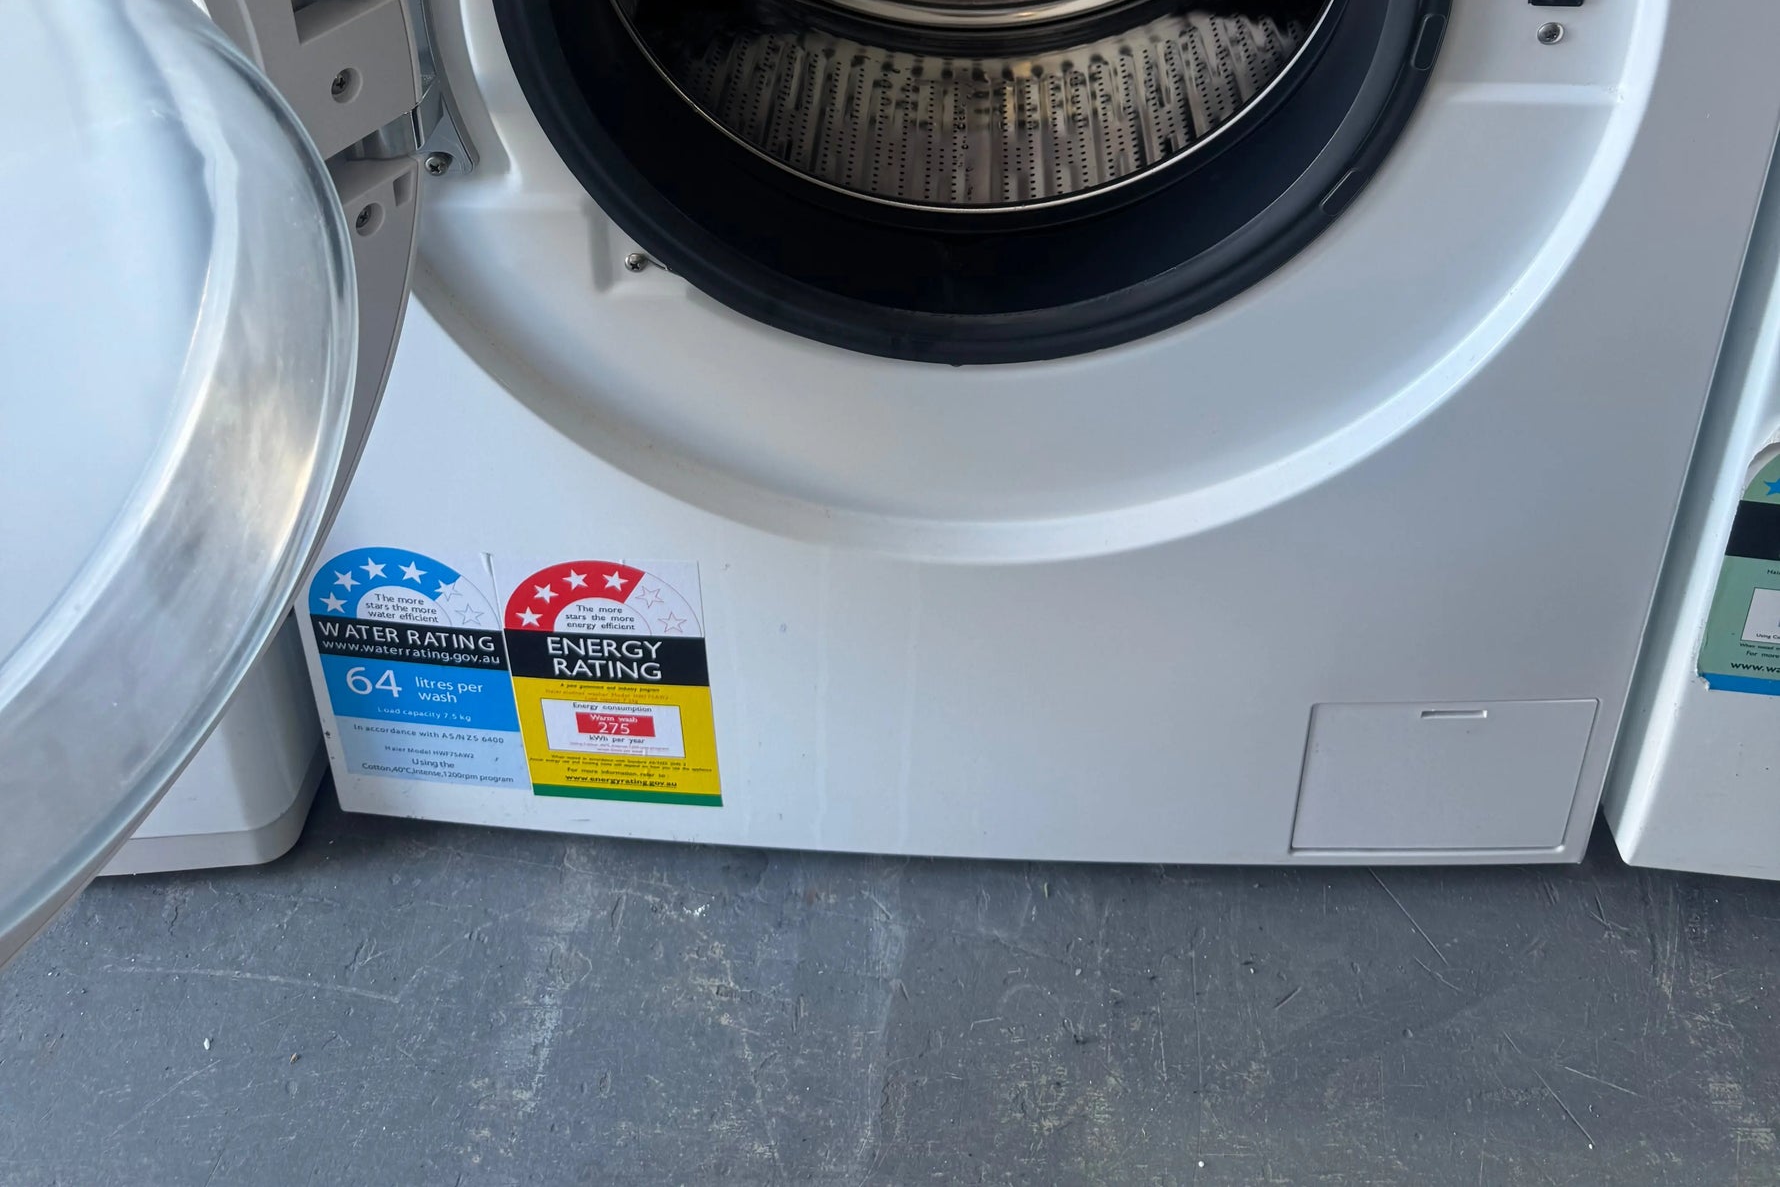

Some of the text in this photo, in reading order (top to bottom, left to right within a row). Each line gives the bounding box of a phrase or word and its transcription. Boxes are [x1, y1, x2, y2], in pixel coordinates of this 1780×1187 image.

[375, 593, 424, 605] The more
[366, 602, 437, 615] stars the more
[576, 604, 593, 613] The
[368, 610, 439, 623] water efficient
[592, 613, 606, 621] the
[567, 622, 635, 630] energy efficient
[318, 621, 495, 652] WATER RATING
[322, 640, 500, 664] www.waterrating.gov.au
[546, 636, 662, 660] ENERGY
[553, 658, 662, 679] RATING
[346, 667, 402, 698] 64
[416, 676, 483, 694] litres per
[418, 691, 457, 703] wash
[573, 702, 652, 713] Energy consumption
[377, 707, 400, 715] Load
[403, 709, 441, 719] capacity
[459, 714, 472, 722] kg
[366, 725, 416, 736] accordance
[419, 730, 439, 738] with
[442, 733, 479, 742] AS/NZS
[598, 722, 630, 734] 275
[412, 758, 455, 769] Using the
[480, 775, 514, 783] program
